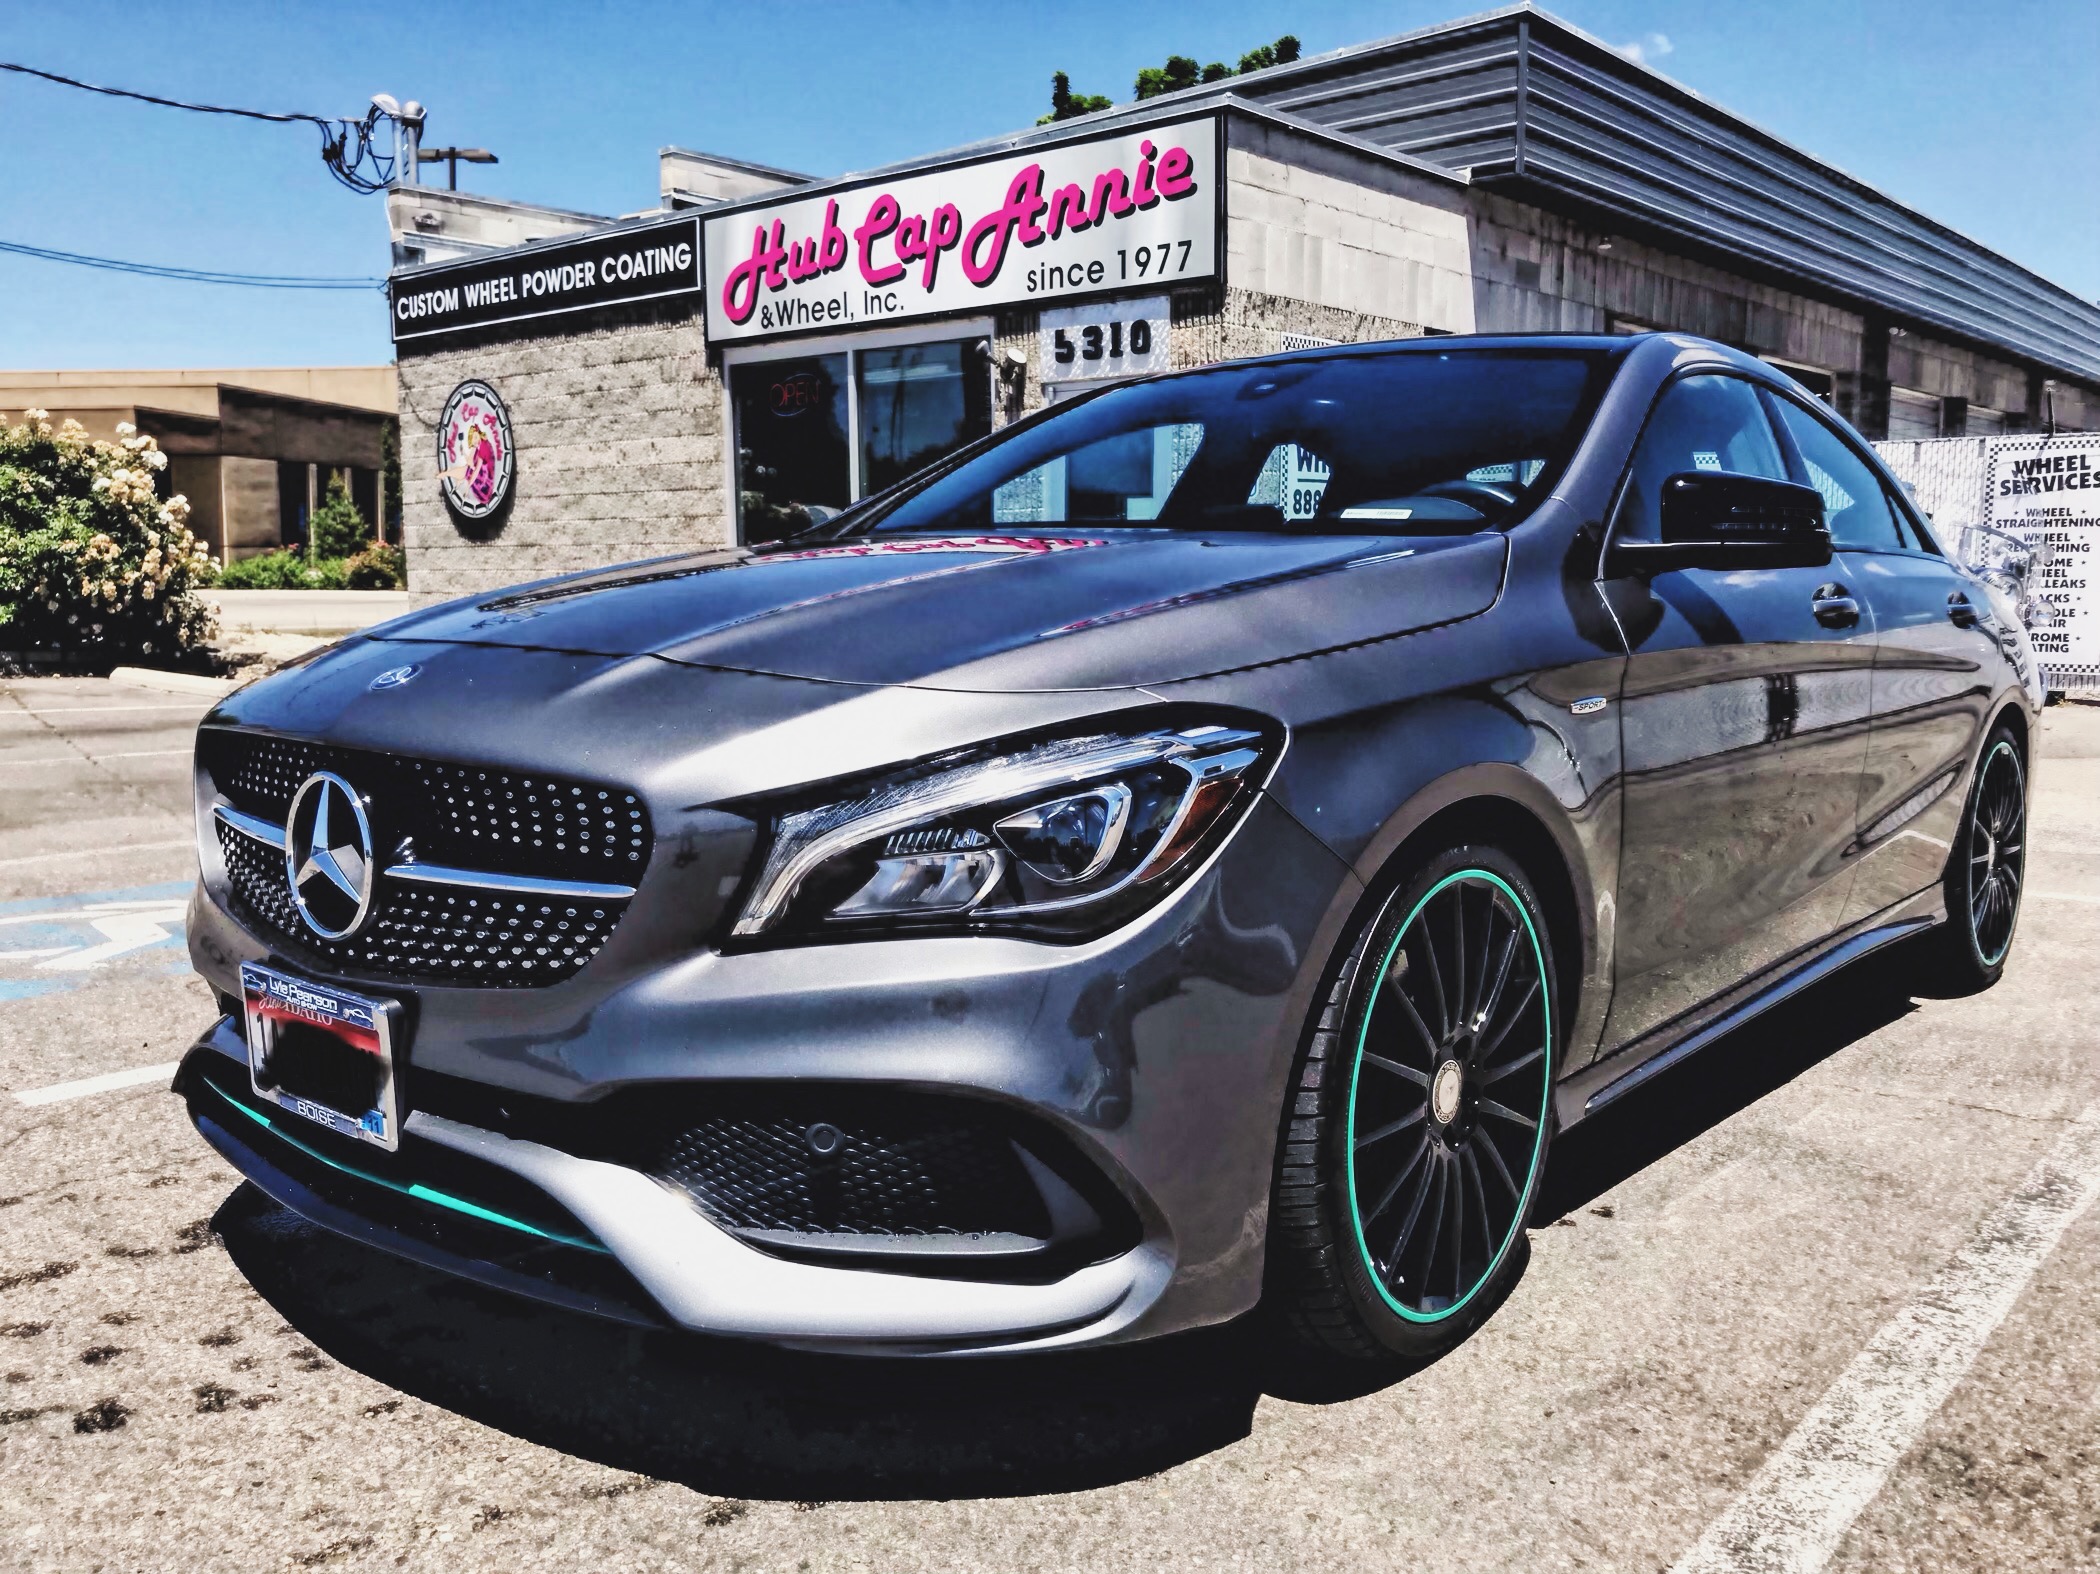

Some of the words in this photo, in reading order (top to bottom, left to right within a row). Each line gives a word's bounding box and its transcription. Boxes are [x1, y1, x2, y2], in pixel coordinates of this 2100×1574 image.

[723, 198, 848, 325] Hub
[853, 193, 963, 293] Cap
[961, 139, 1198, 288] Annie
[396, 287, 460, 321] CUSTOM
[463, 276, 518, 308] WHEEL
[522, 261, 596, 298] POWDER
[601, 242, 692, 283] COATING
[1026, 259, 1105, 293] since
[1116, 239, 1193, 280] 1977
[863, 290, 905, 316] Inc.
[1054, 318, 1152, 364] 5310
[769, 381, 820, 406] OPEN
[2012, 454, 2092, 476] WHEEL
[269, 976, 289, 995] Lyle
[288, 983, 338, 1011] Pearson
[297, 1100, 337, 1128] BOISE
